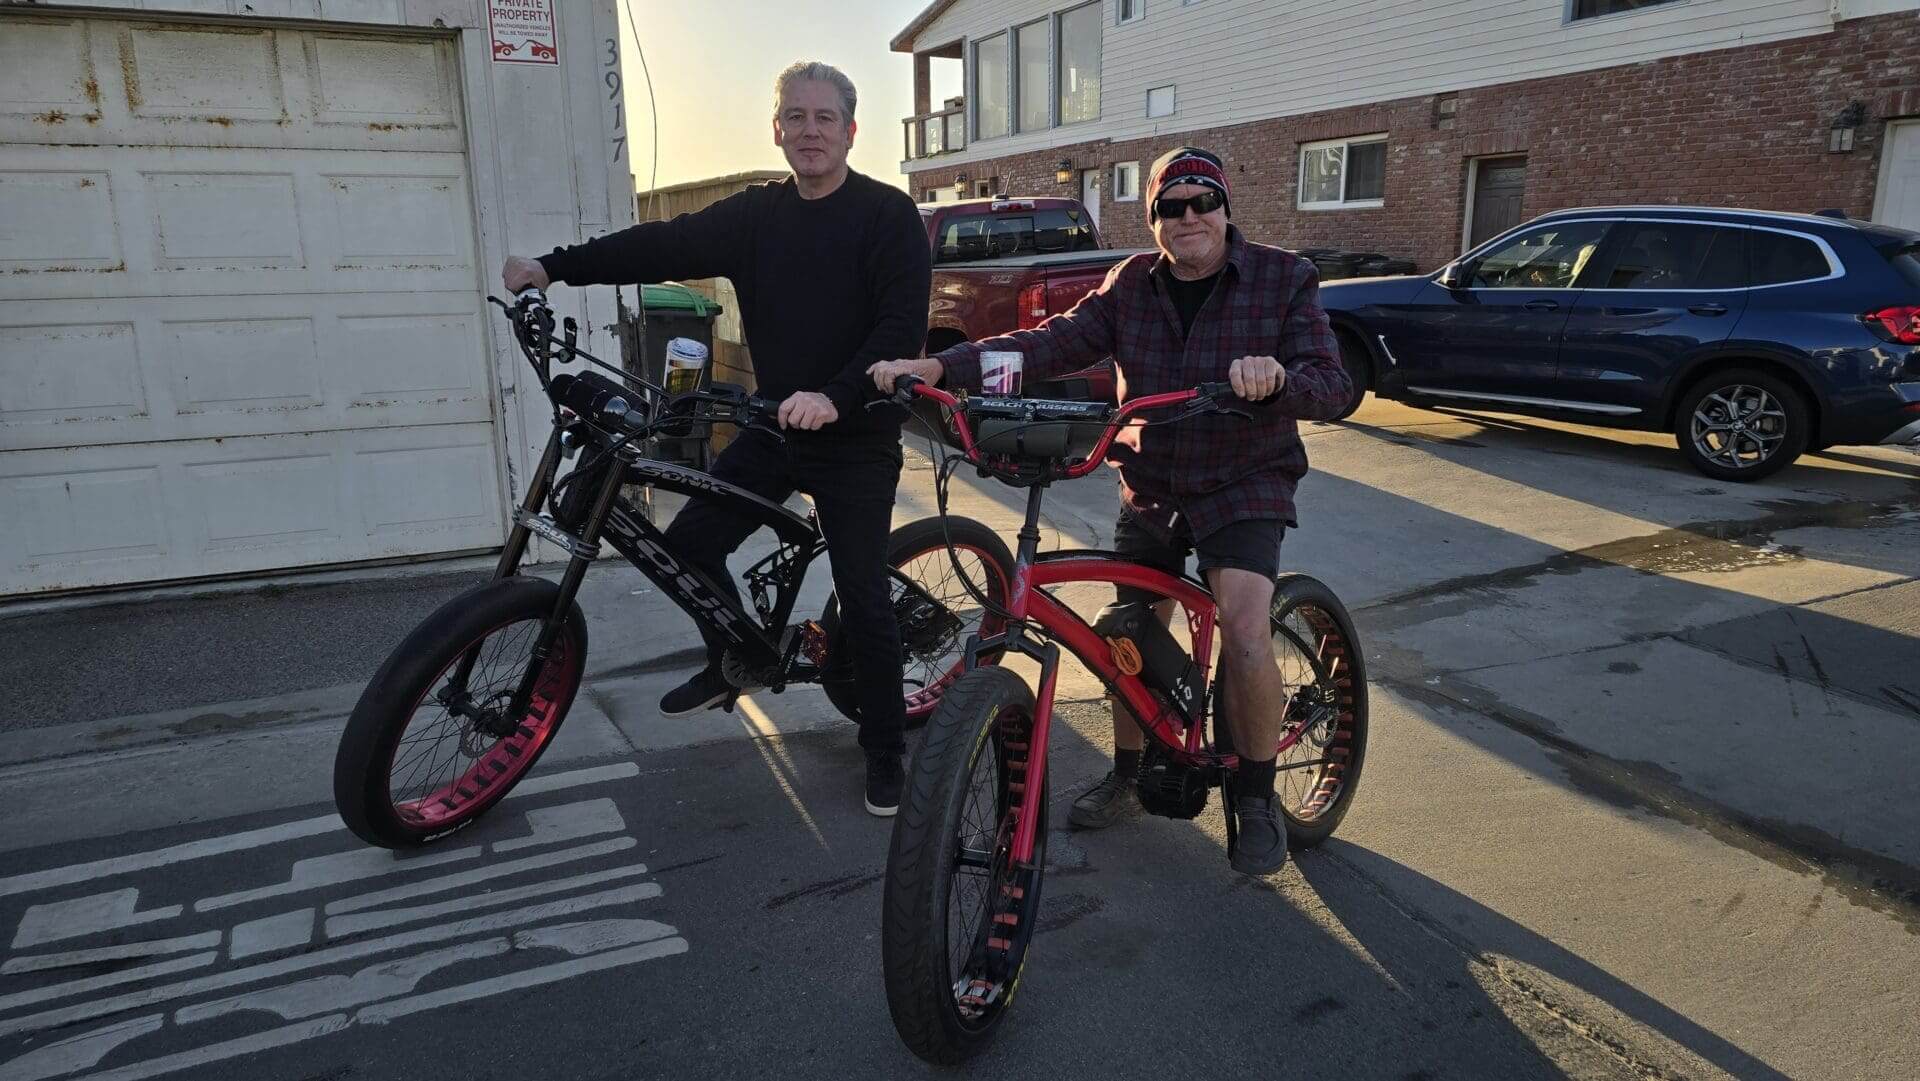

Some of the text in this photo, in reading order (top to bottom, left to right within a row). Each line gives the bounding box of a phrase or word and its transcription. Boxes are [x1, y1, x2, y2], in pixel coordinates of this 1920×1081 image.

[493, 8, 549, 22] PROPERTY
[604, 38, 625, 163] 3917
[982, 400, 1088, 412] BEACH UISERS
[638, 466, 733, 496] SONIC
[608, 506, 744, 643] SOUL
